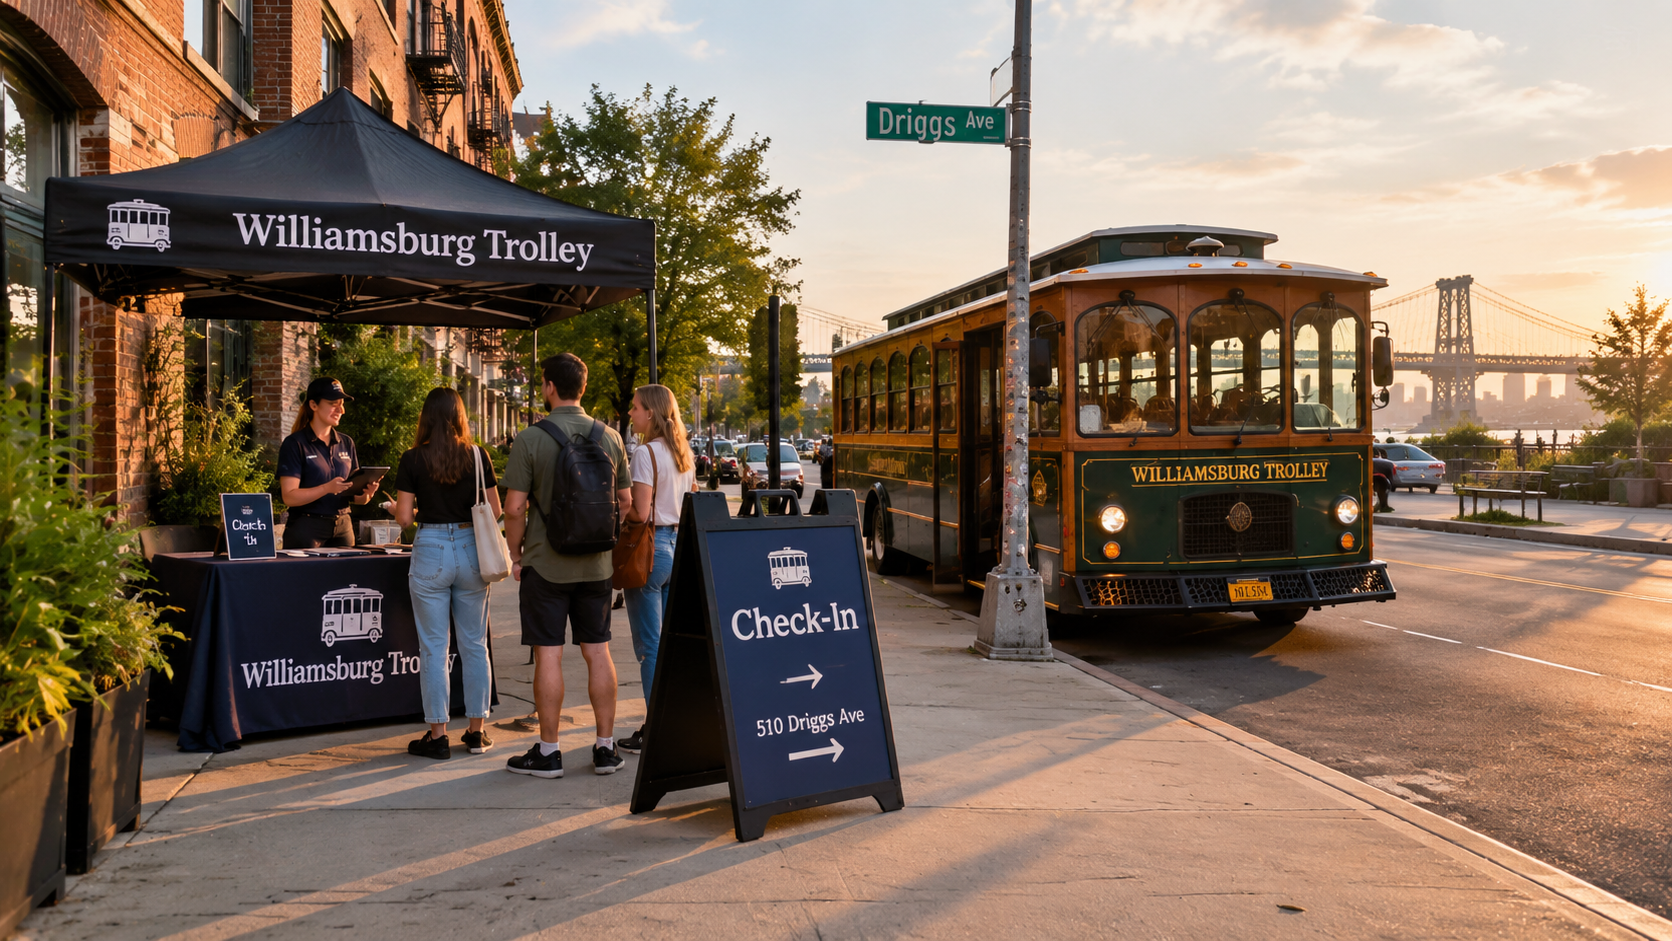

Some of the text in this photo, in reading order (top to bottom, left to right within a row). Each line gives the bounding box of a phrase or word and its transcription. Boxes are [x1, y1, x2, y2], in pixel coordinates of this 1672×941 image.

[879, 107, 994, 141] Driggs Ave
[232, 212, 594, 272] Williamsburg Trolley
[1131, 460, 1330, 483] WILLIAMSBURG TROLLEY
[731, 602, 859, 641] Check-In
[241, 651, 457, 689] Williamsburg Troy
[756, 708, 865, 737] 510 Driggs Ave
